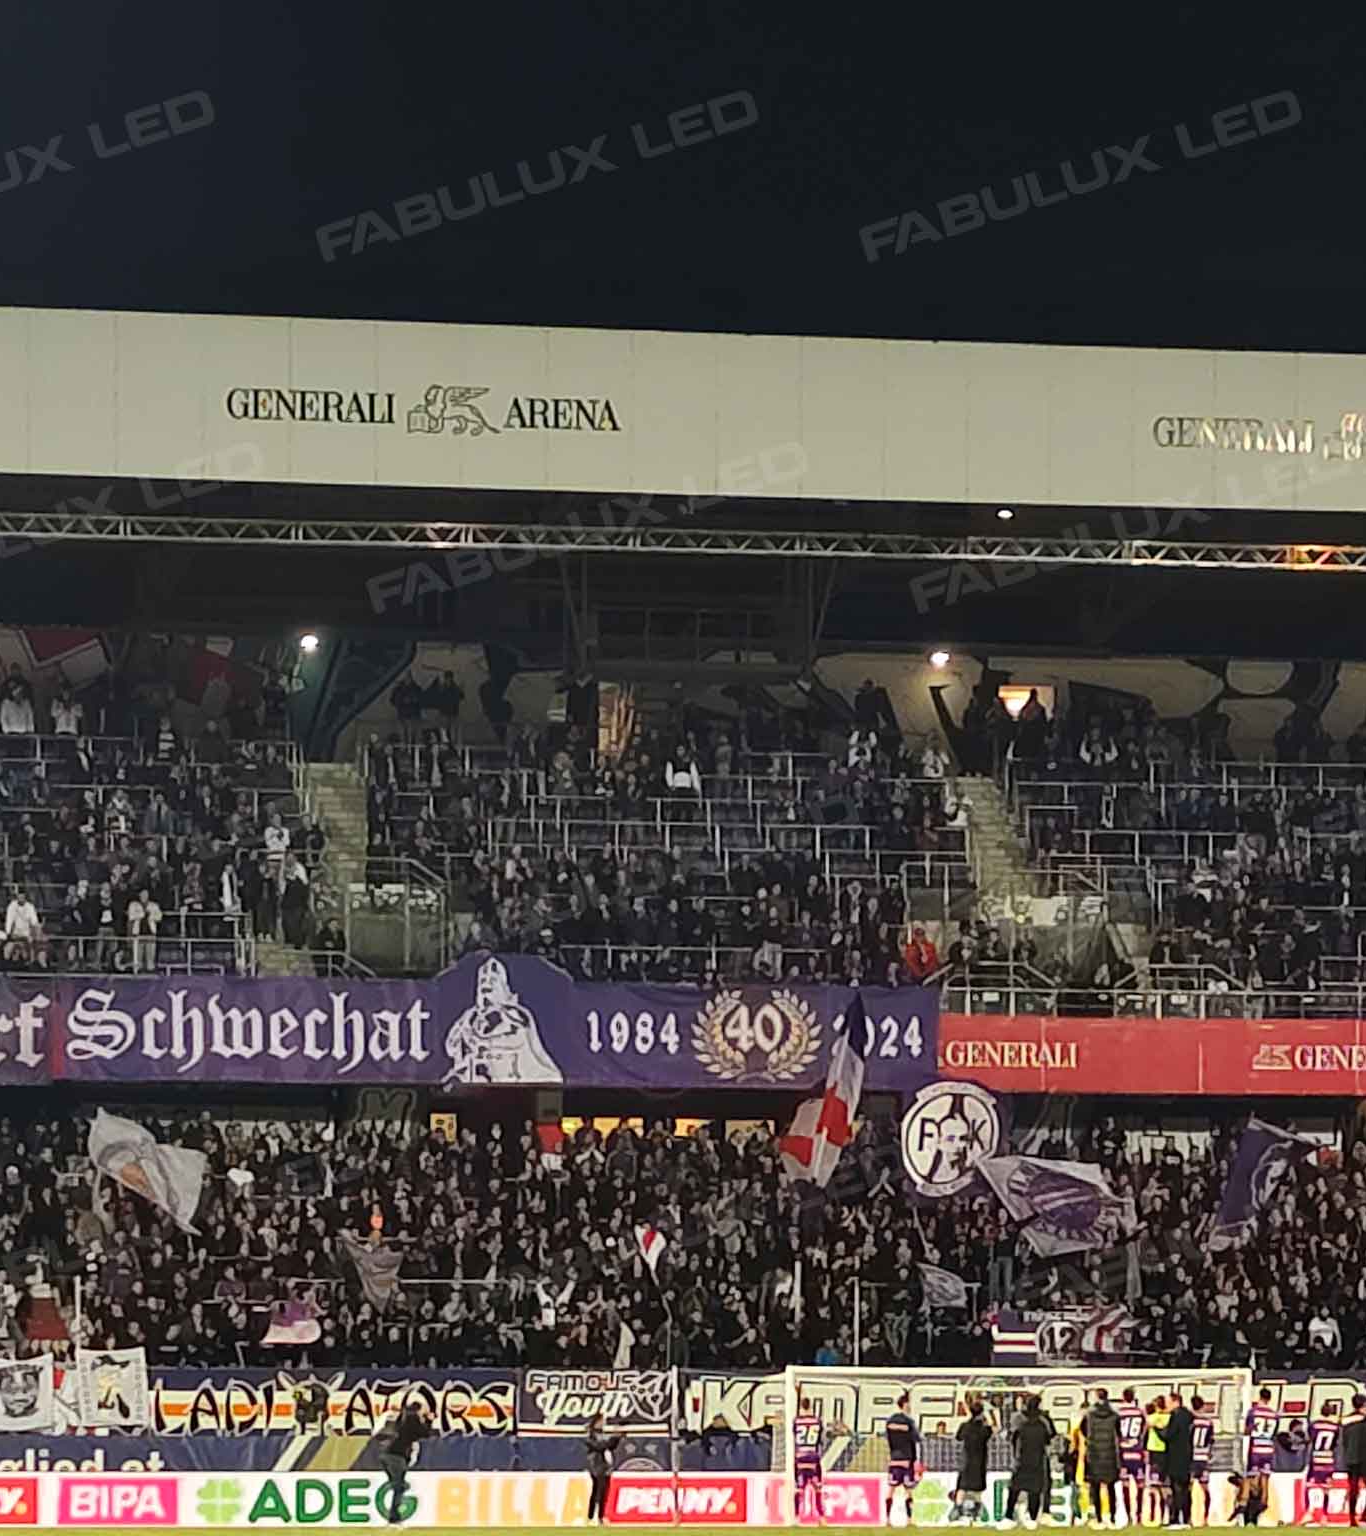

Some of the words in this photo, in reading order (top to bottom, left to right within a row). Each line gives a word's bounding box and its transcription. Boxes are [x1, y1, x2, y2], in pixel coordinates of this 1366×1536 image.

[227, 388, 395, 425] GENERALI
[504, 397, 621, 432] ARENA
[1153, 416, 1315, 454] GENERALI
[66, 988, 431, 1074] Schwechat
[586, 1010, 680, 1055] 1984
[723, 1003, 783, 1045] 40
[945, 1040, 1079, 1069] GENERALI
[795, 1423, 820, 1446] 26
[68, 1485, 166, 1519] BIPA
[248, 1478, 420, 1523] ADEG
[436, 1478, 591, 1525] BILLA
